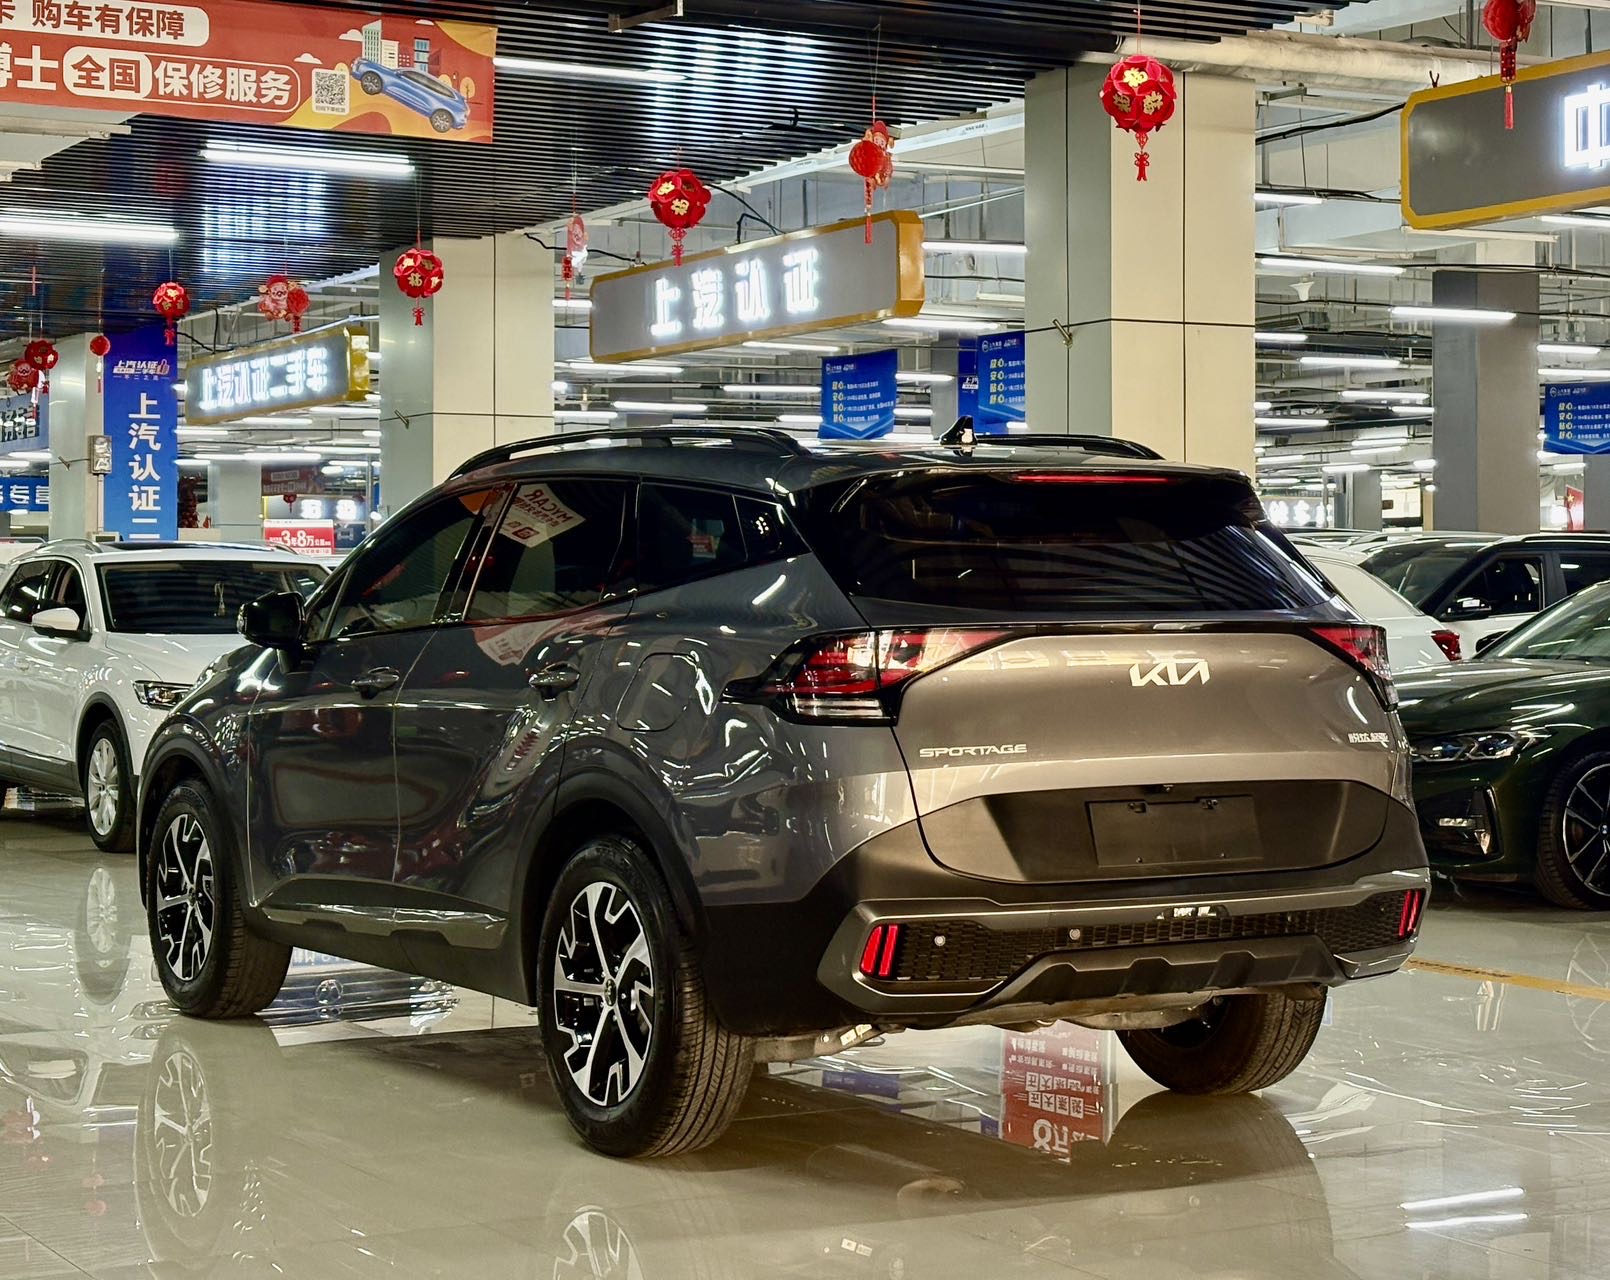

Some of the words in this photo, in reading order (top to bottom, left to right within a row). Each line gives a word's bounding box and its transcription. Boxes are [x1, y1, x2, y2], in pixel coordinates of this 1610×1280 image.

[32, 0, 185, 40] 购车有保障
[650, 247, 820, 338] 上汽认证
[199, 346, 328, 410] 上汽认证二手车
[1129, 661, 1211, 687] KIA
[919, 743, 1028, 758] SPORTAGE
